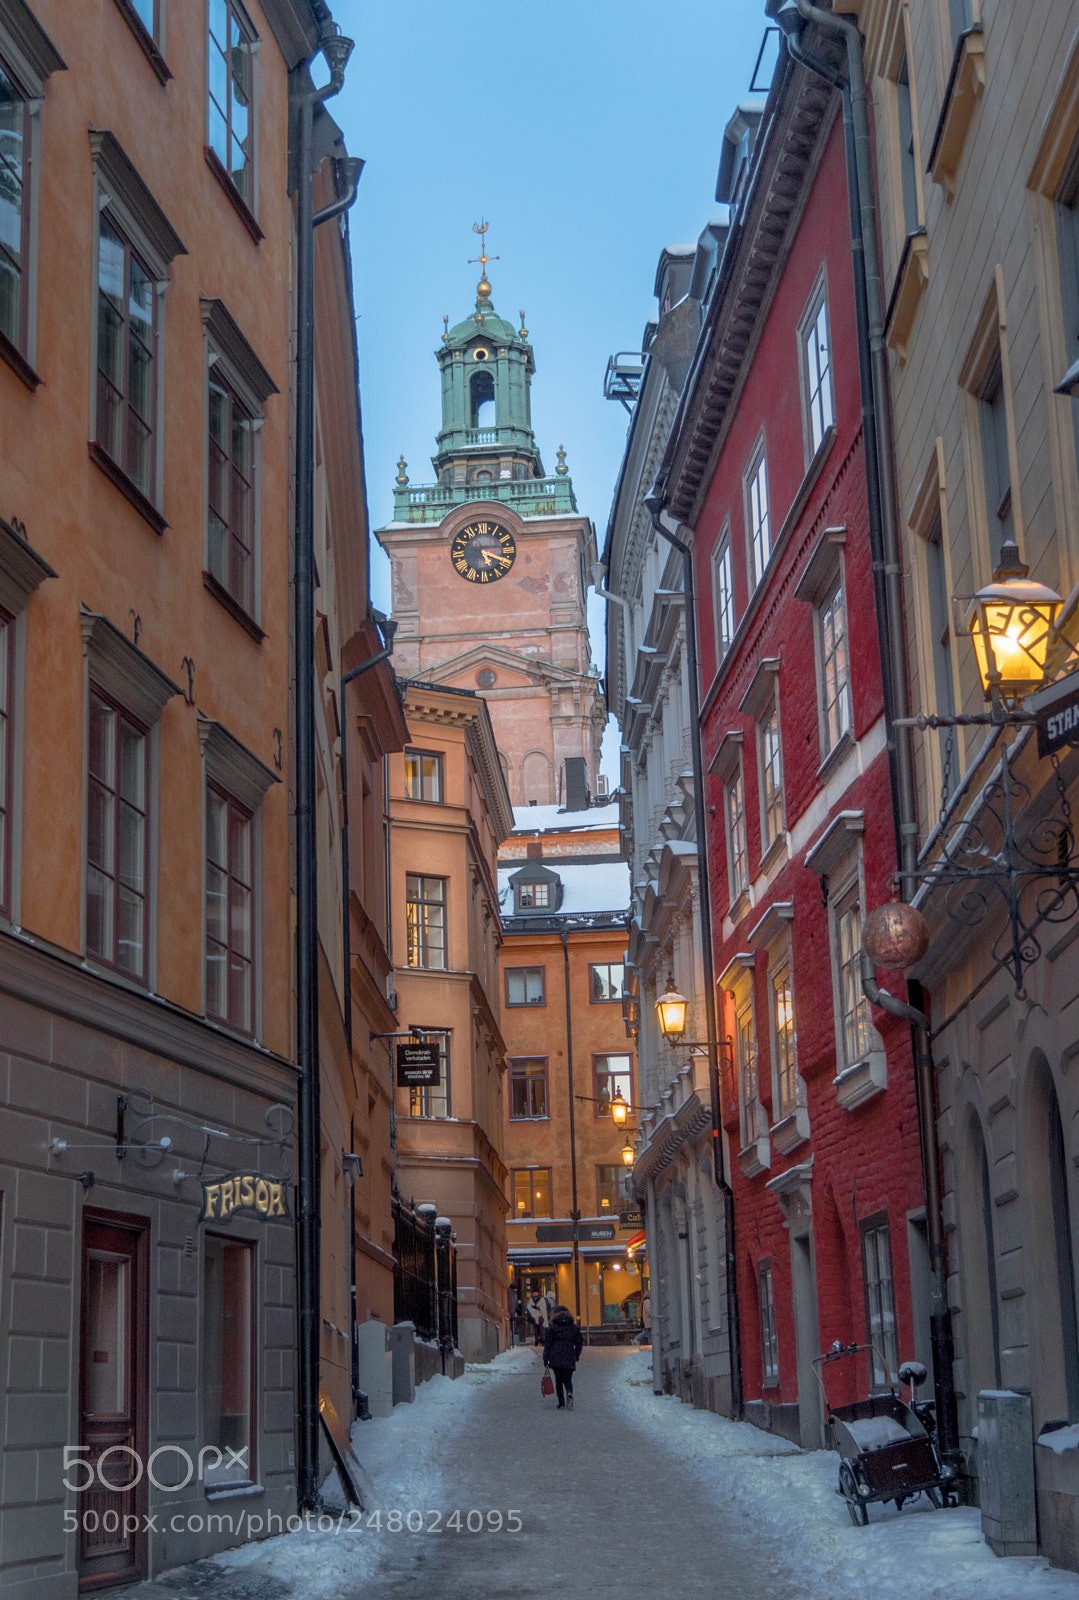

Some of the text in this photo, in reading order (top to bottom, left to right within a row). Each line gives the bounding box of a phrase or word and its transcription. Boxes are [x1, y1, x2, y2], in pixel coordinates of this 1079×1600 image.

[478, 523, 487, 534] XII
[456, 537, 467, 546] X
[499, 534, 511, 544] II
